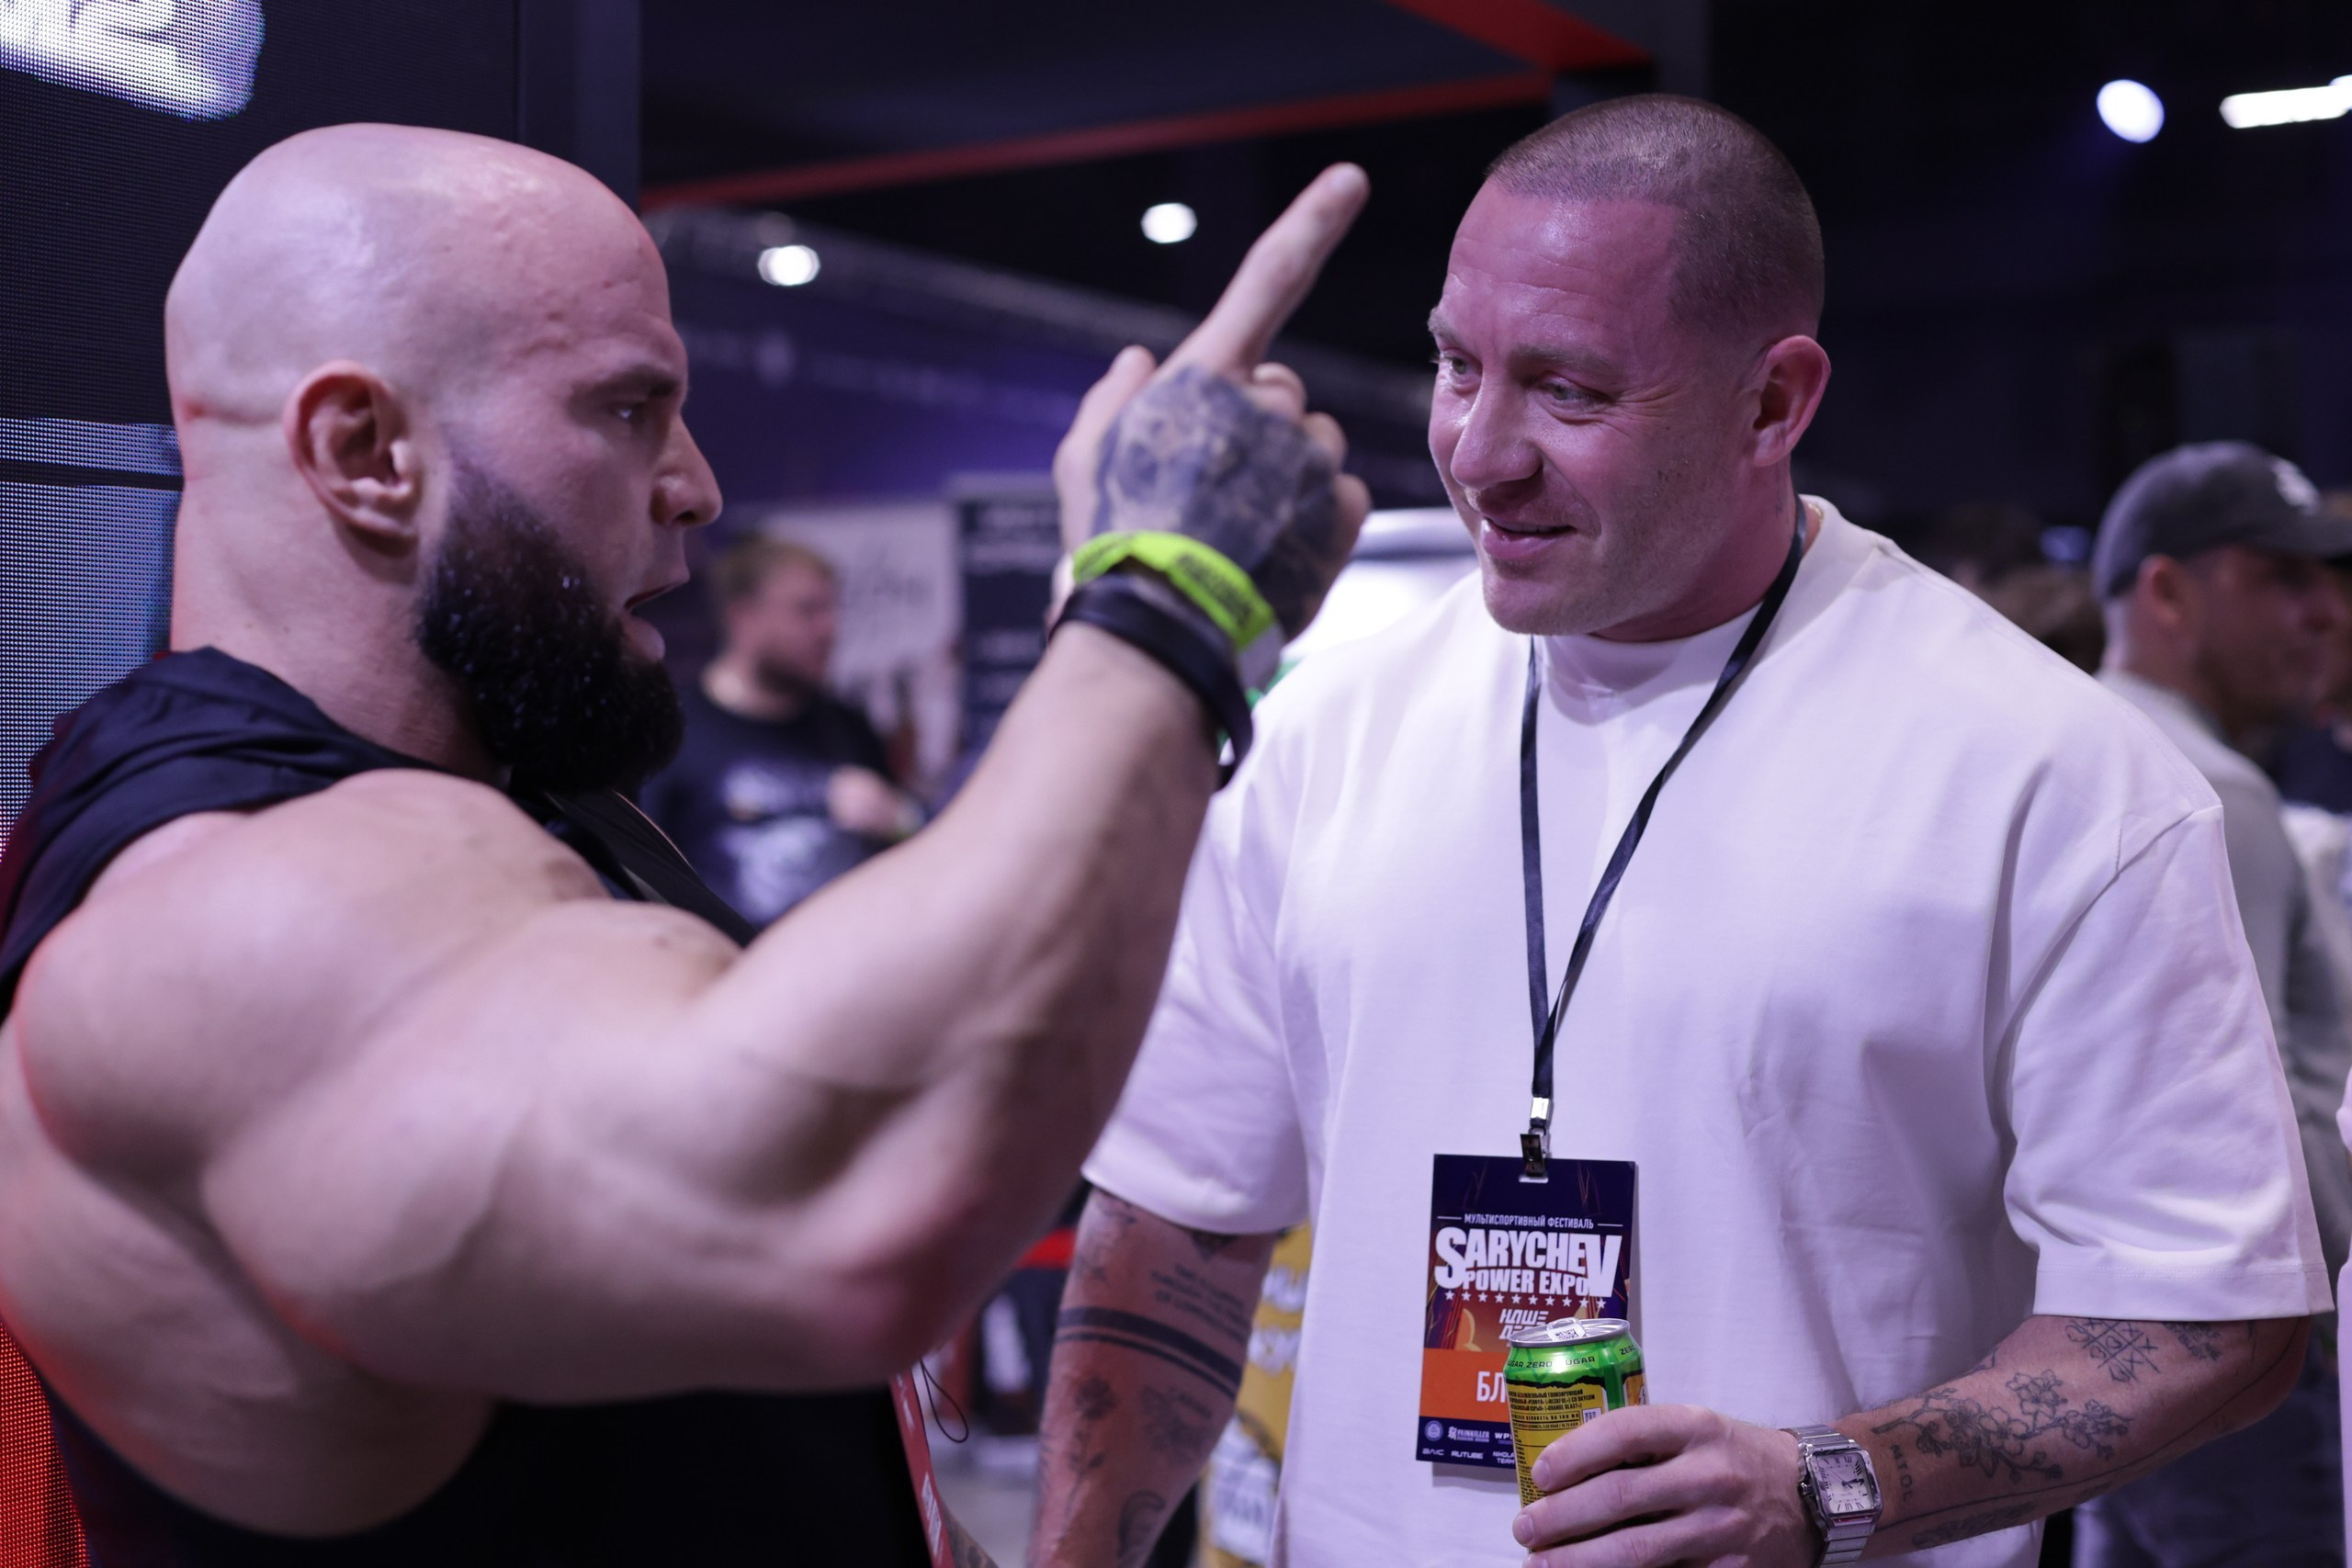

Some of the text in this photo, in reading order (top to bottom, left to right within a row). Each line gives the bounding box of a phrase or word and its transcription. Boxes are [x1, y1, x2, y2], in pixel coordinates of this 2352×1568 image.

[1464, 1213, 1594, 1229] МУЛЬТИСПОРТИВНЫЙ ФЕСТИВАЛЬ
[1434, 1226, 1623, 1298] SARYCHEV
[1463, 1269, 1590, 1296] POWER EXPO
[1619, 1344, 1636, 1356] ZER
[1526, 1360, 1553, 1369] ZERO
[1565, 1356, 1596, 1366] UGAR
[1476, 1371, 1506, 1404] БЛ
[1451, 1450, 1484, 1460] RUTUBE
[1497, 1457, 1516, 1465] TEAM
